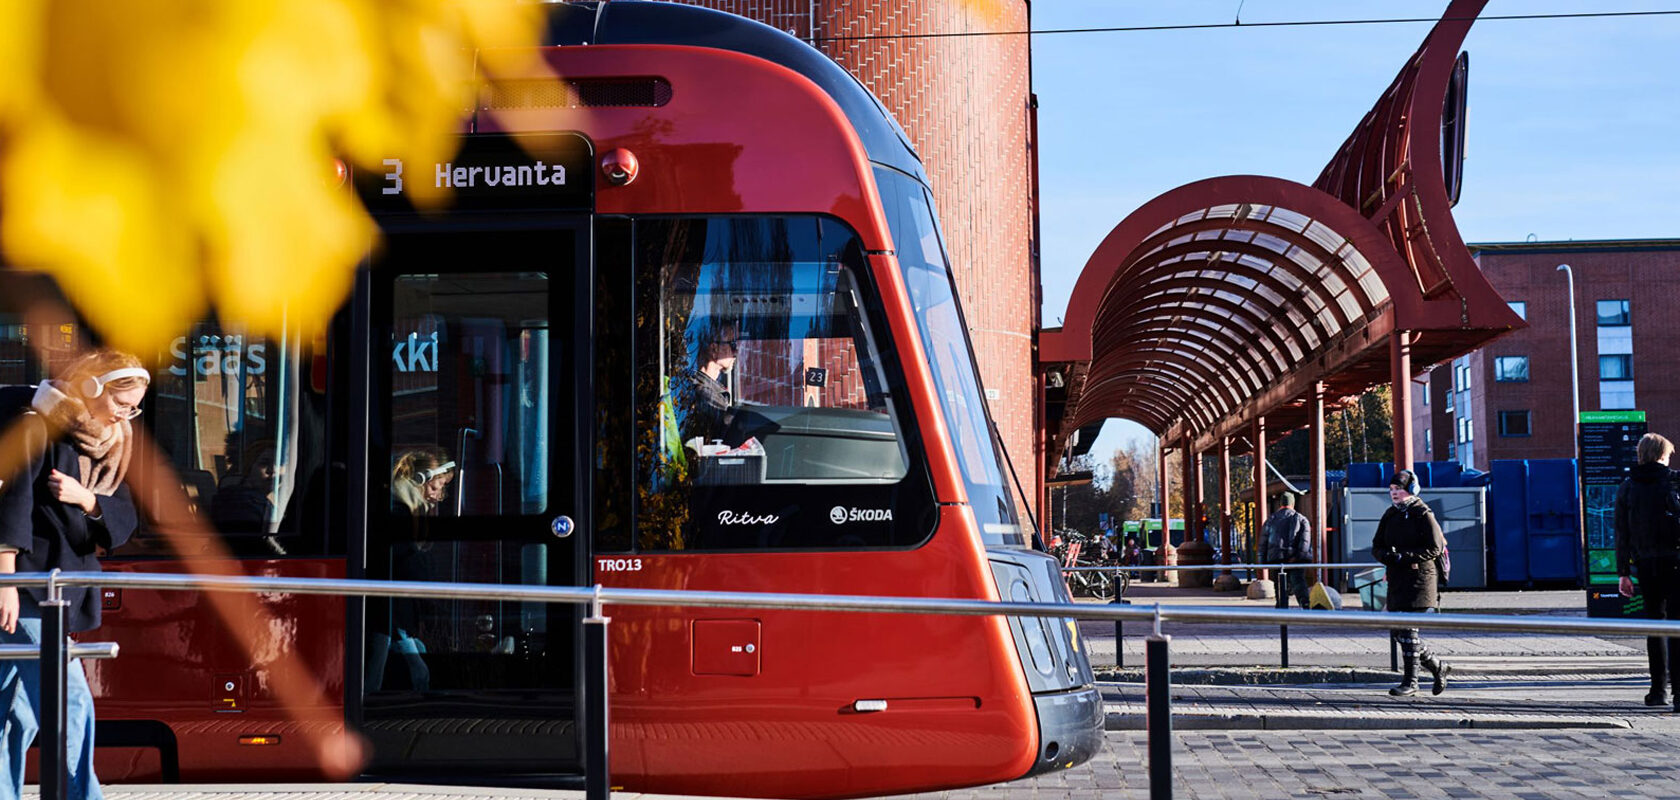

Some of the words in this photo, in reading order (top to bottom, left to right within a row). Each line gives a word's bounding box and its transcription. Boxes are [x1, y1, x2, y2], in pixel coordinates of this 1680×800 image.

[382, 158, 403, 195] 3
[435, 160, 566, 188] Hervanta
[809, 371, 824, 383] 23
[717, 509, 780, 525] Ritva
[849, 507, 893, 521] ŠKODA
[598, 558, 642, 572] TRO13
